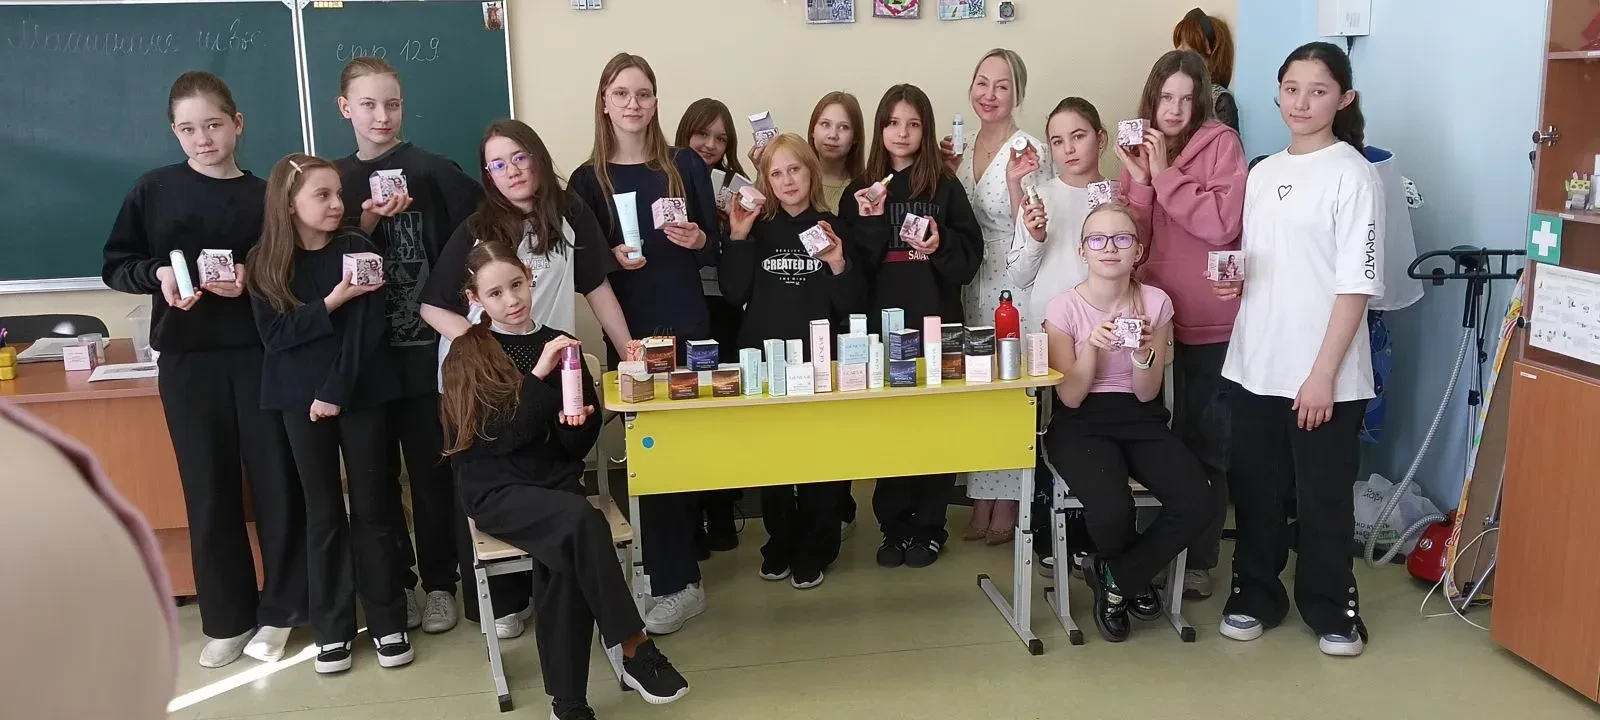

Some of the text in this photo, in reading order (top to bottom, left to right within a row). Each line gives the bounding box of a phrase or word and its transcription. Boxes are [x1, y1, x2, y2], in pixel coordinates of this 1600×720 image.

[763, 258, 820, 271] CREATED BY
[1364, 219, 1376, 280] TOMATO
